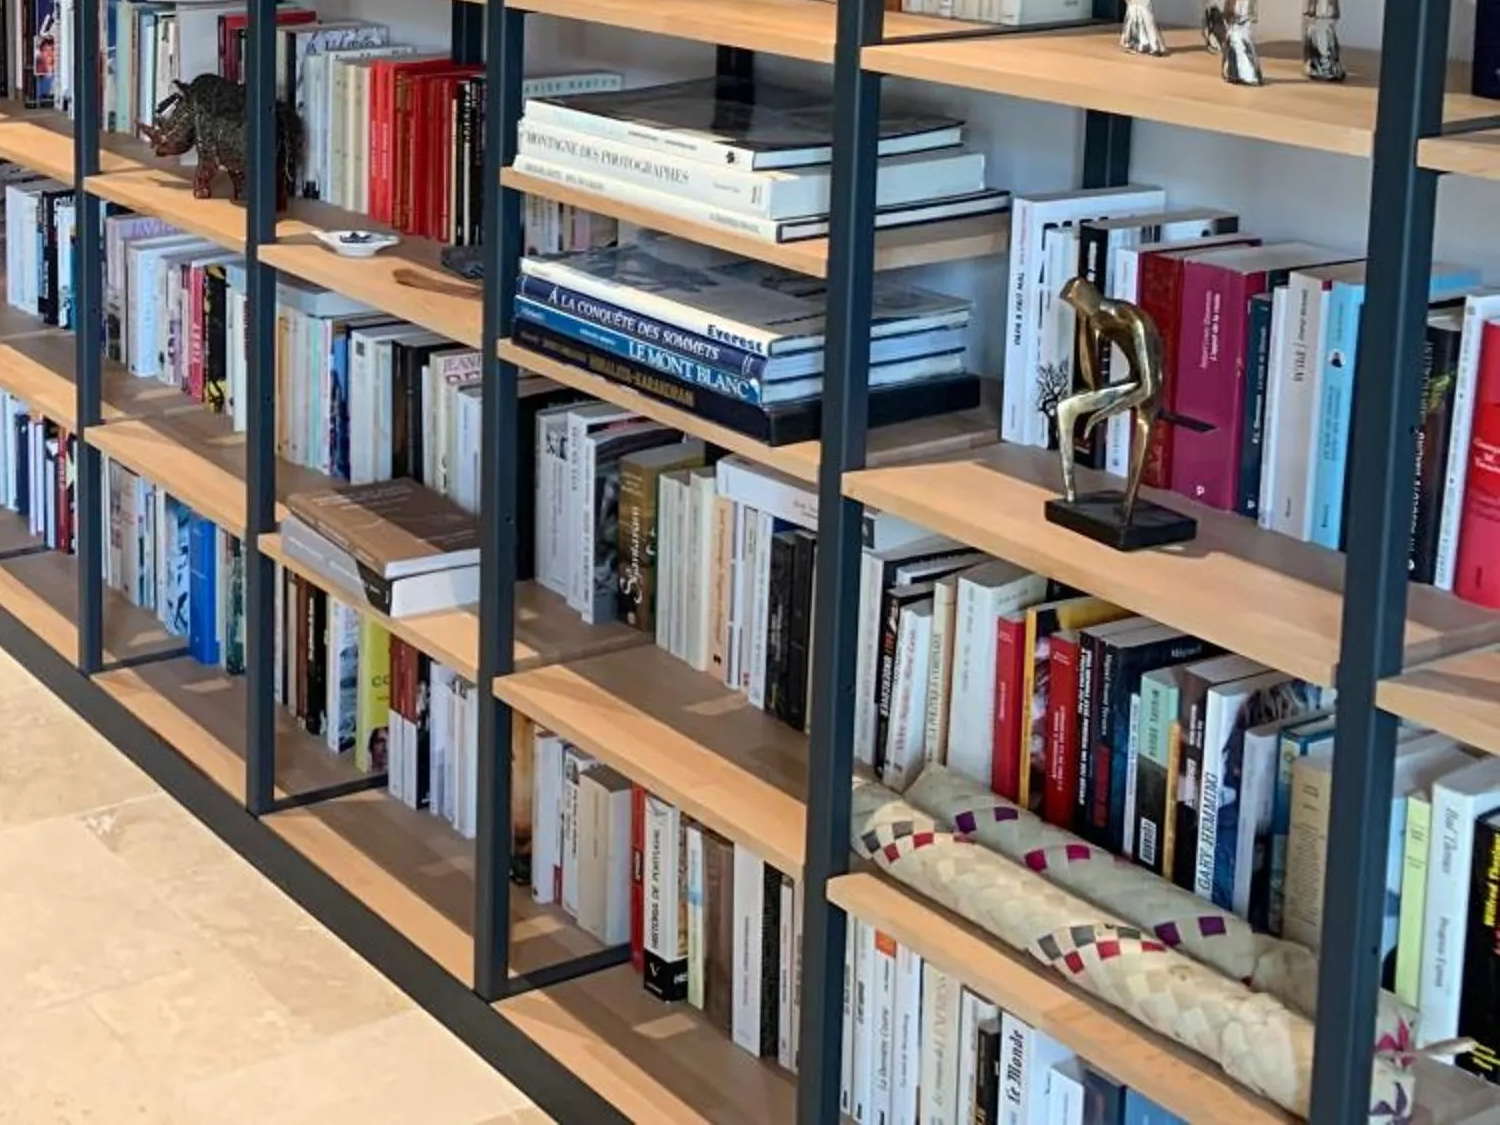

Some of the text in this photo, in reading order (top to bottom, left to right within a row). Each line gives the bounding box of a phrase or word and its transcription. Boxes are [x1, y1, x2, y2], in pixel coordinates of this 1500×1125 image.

[559, 294, 578, 311] LA
[578, 300, 637, 332] CONQUÊTE
[635, 321, 660, 340] DES
[661, 330, 721, 361] SOMMETS
[706, 323, 764, 353] Everest
[627, 341, 751, 400] LE MONT BLANC
[1197, 771, 1218, 891] GARY HEMMING
[1007, 1029, 1025, 1105] Le Monde
